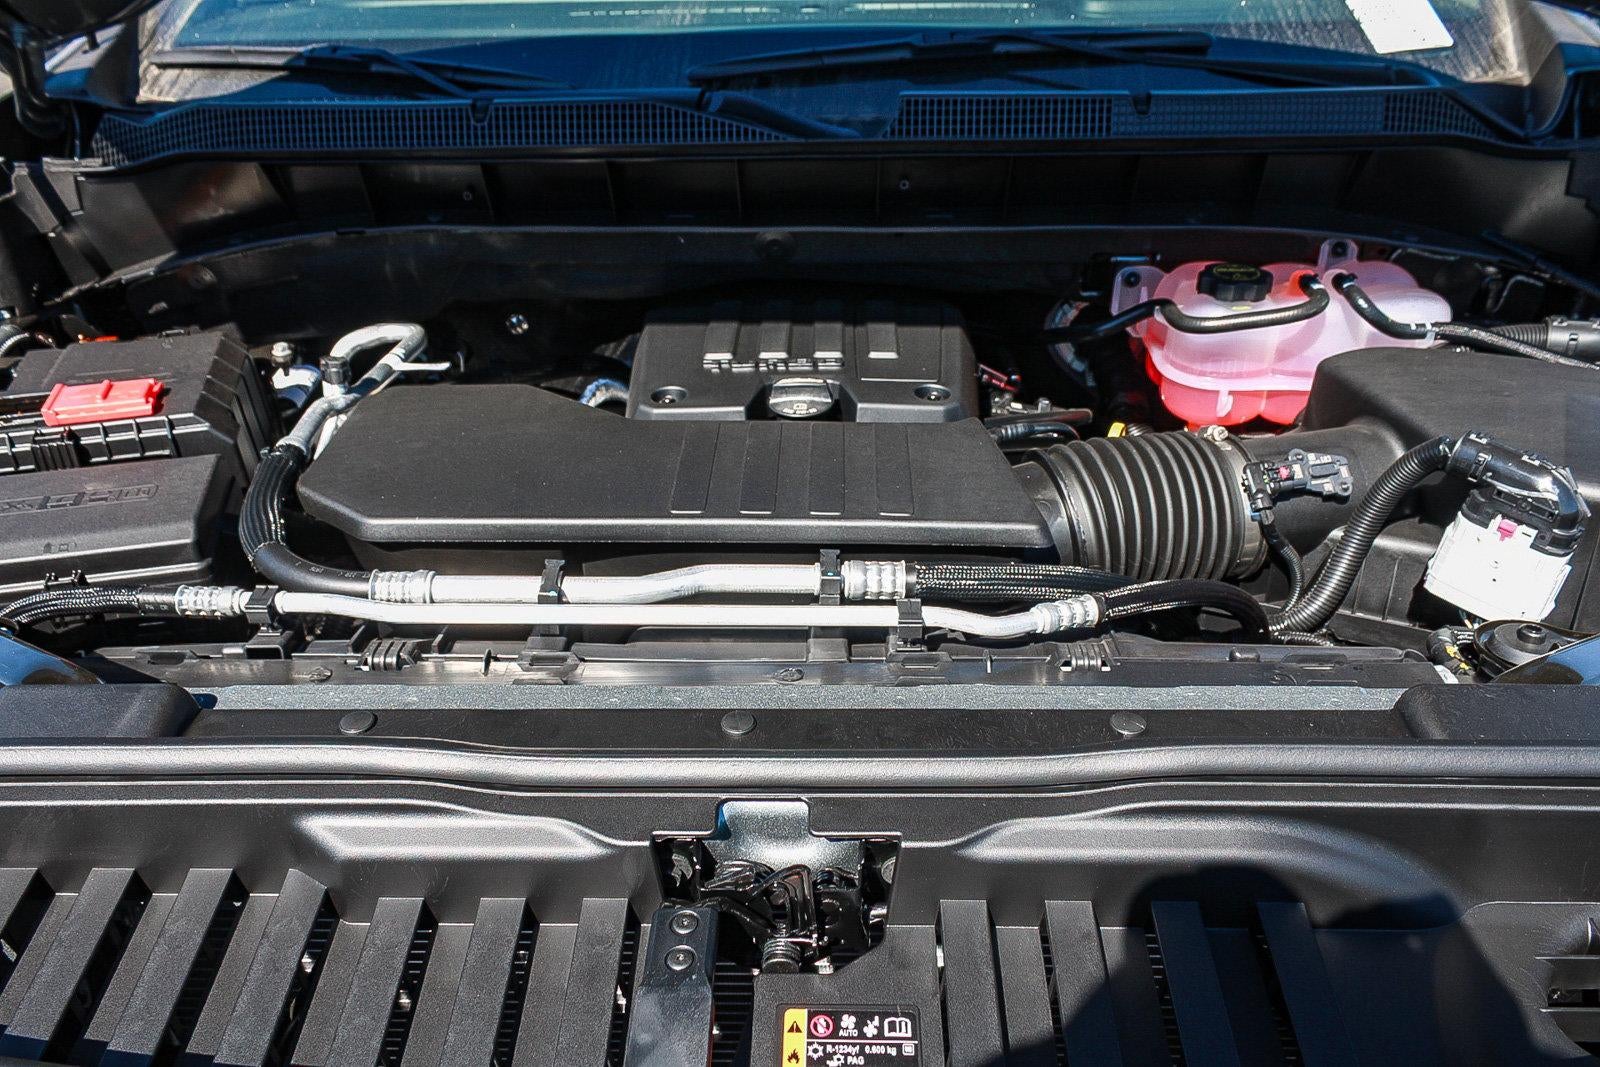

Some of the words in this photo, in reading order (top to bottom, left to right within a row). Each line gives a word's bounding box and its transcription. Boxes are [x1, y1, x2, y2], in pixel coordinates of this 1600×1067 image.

[839, 1029, 859, 1037] AUTO
[826, 1044, 860, 1056] R-1234yf
[886, 1045, 897, 1057] kg
[847, 1056, 865, 1065] PAG
